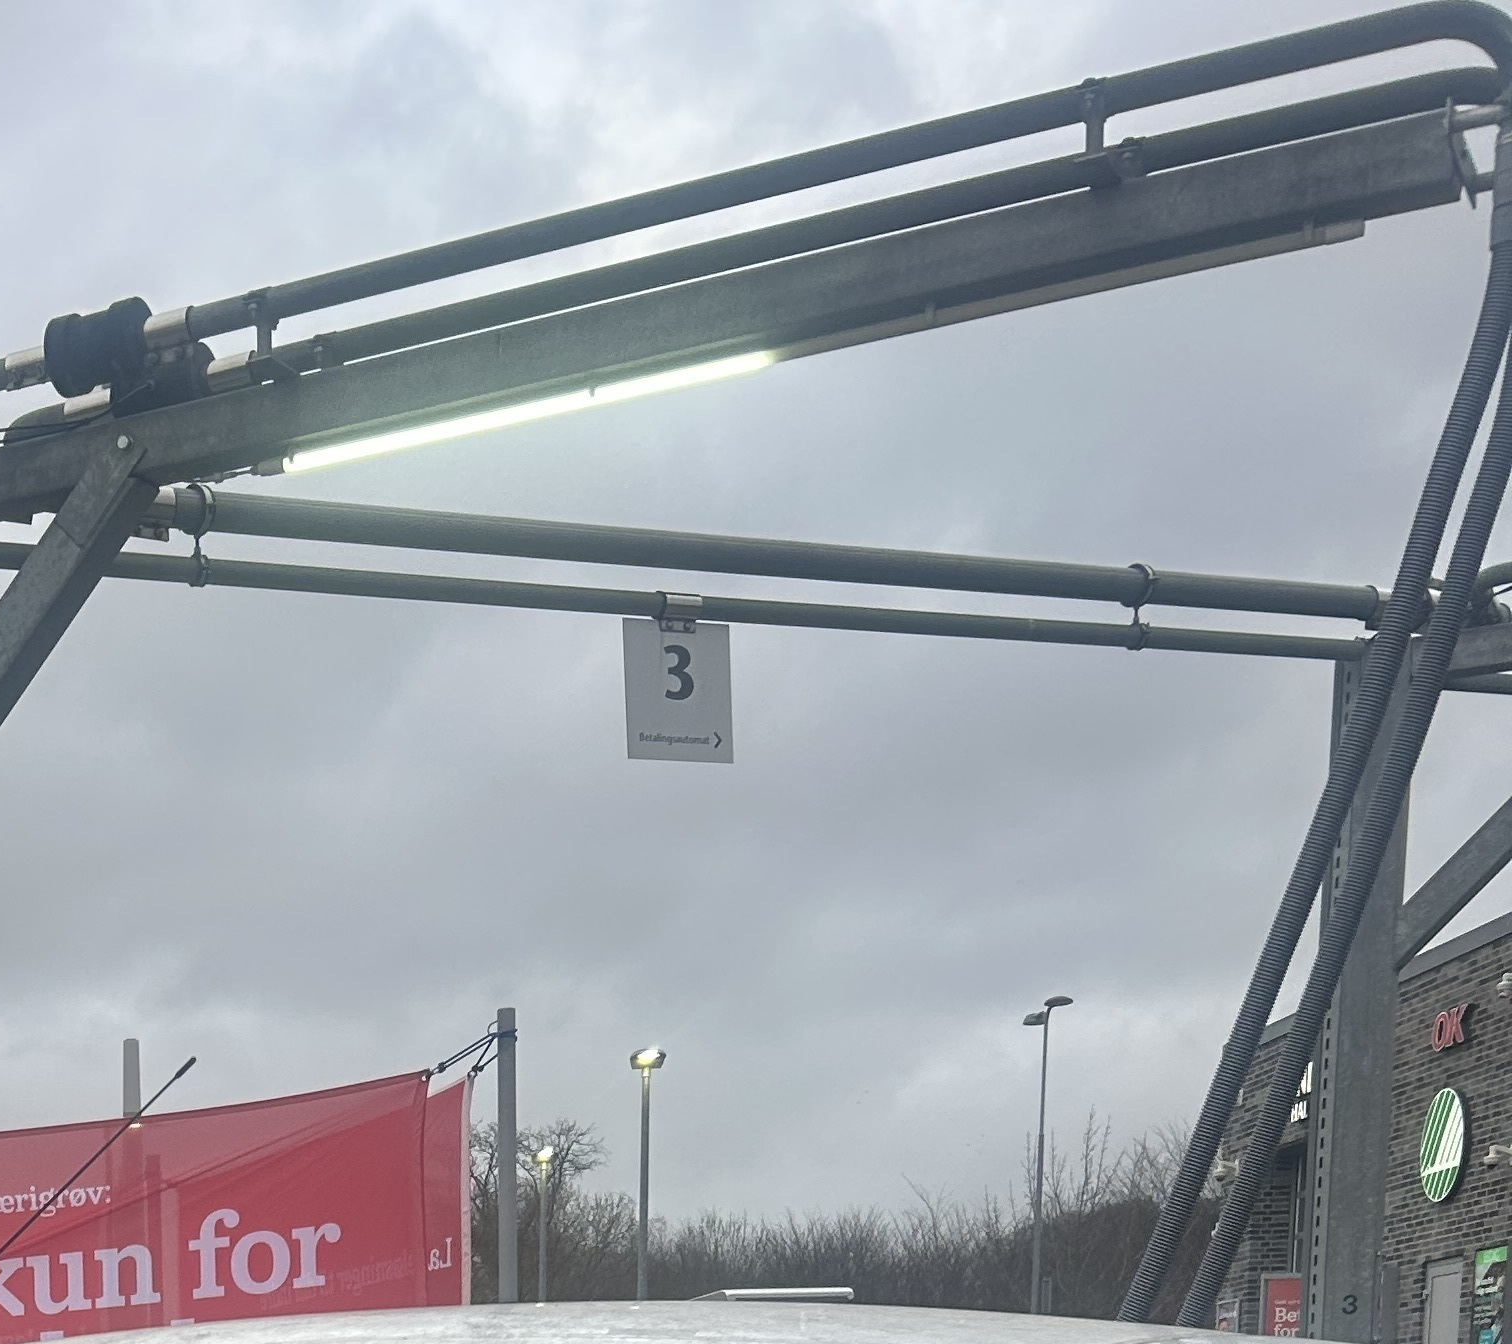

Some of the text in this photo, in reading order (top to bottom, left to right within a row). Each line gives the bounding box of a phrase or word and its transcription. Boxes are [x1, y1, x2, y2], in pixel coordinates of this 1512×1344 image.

[663, 644, 694, 701] 3
[1431, 1003, 1468, 1052] OK
[188, 1207, 342, 1300] for
[1342, 1294, 1358, 1315] 3
